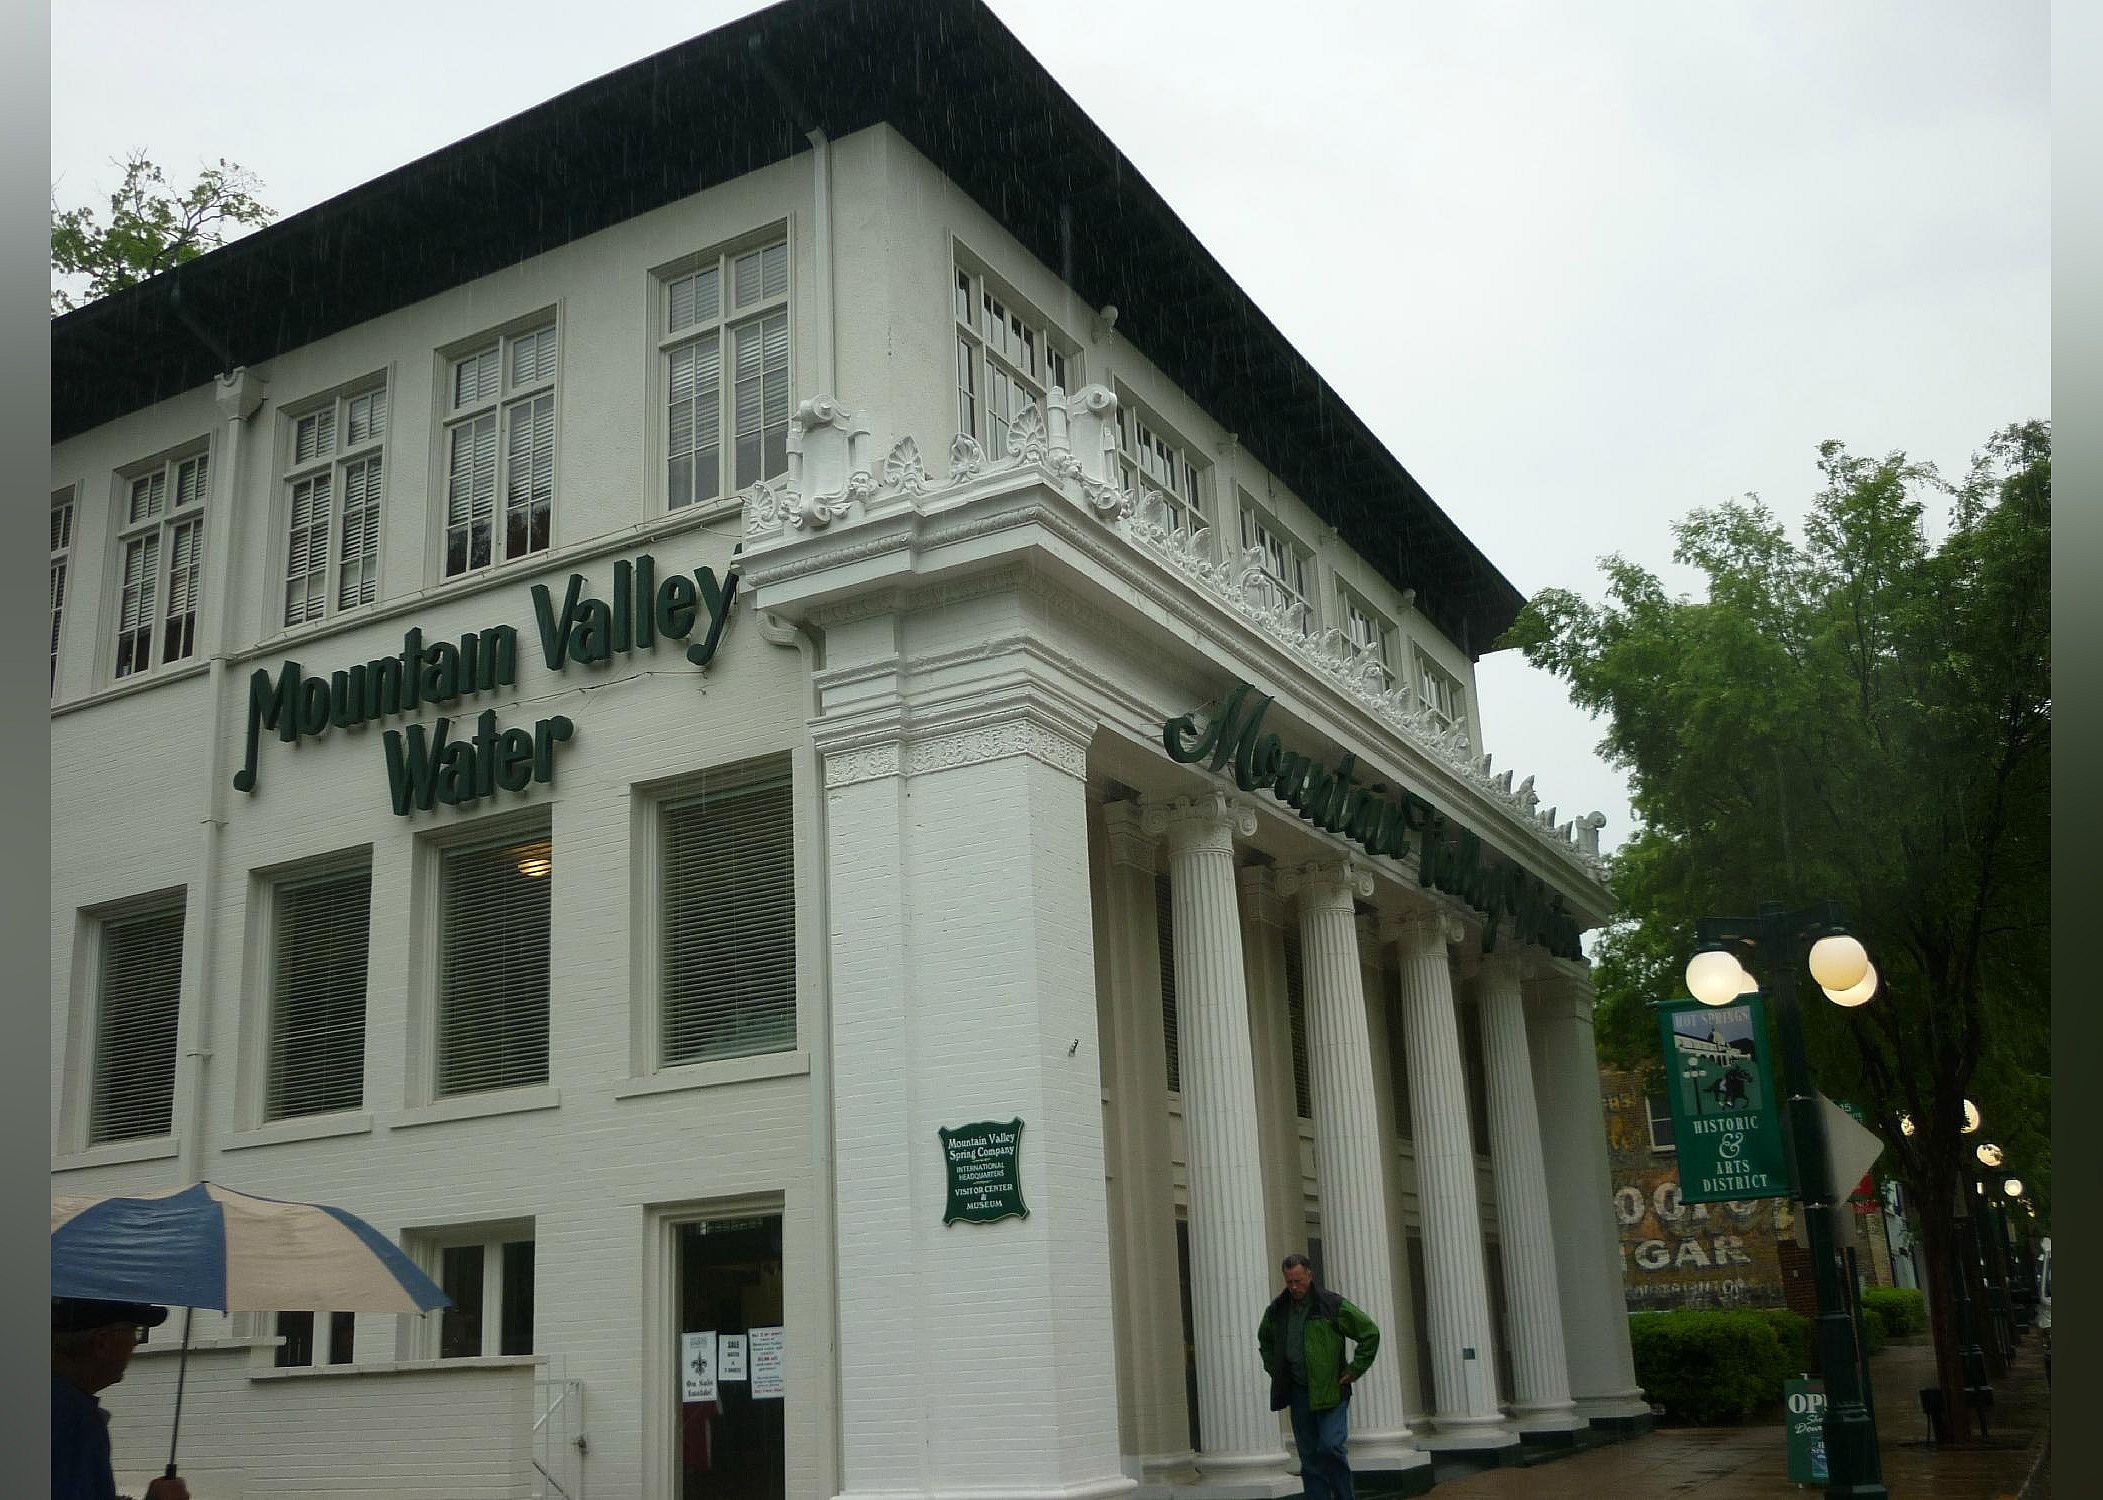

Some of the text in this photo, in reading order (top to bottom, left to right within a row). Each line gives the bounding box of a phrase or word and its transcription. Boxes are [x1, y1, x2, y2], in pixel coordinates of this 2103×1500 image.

[233, 542, 742, 793] Mountain Valley
[382, 708, 575, 817] Water
[1693, 1116, 1759, 1134] HISTORIC
[948, 1132, 1015, 1149] Mountain Valley
[1719, 1132, 1744, 1159] &
[949, 1145, 1015, 1161] Spring Company
[957, 1161, 1004, 1173] INTERNATIONAL
[959, 1170, 1005, 1181] HEADQUARTERS
[1716, 1159, 1750, 1175] ARTS
[955, 1183, 1014, 1197] VISITOR CENTER
[1702, 1174, 1768, 1193] DISTRICT
[966, 1200, 1003, 1210] MUSEUM
[1788, 1393, 1828, 1414] OP
